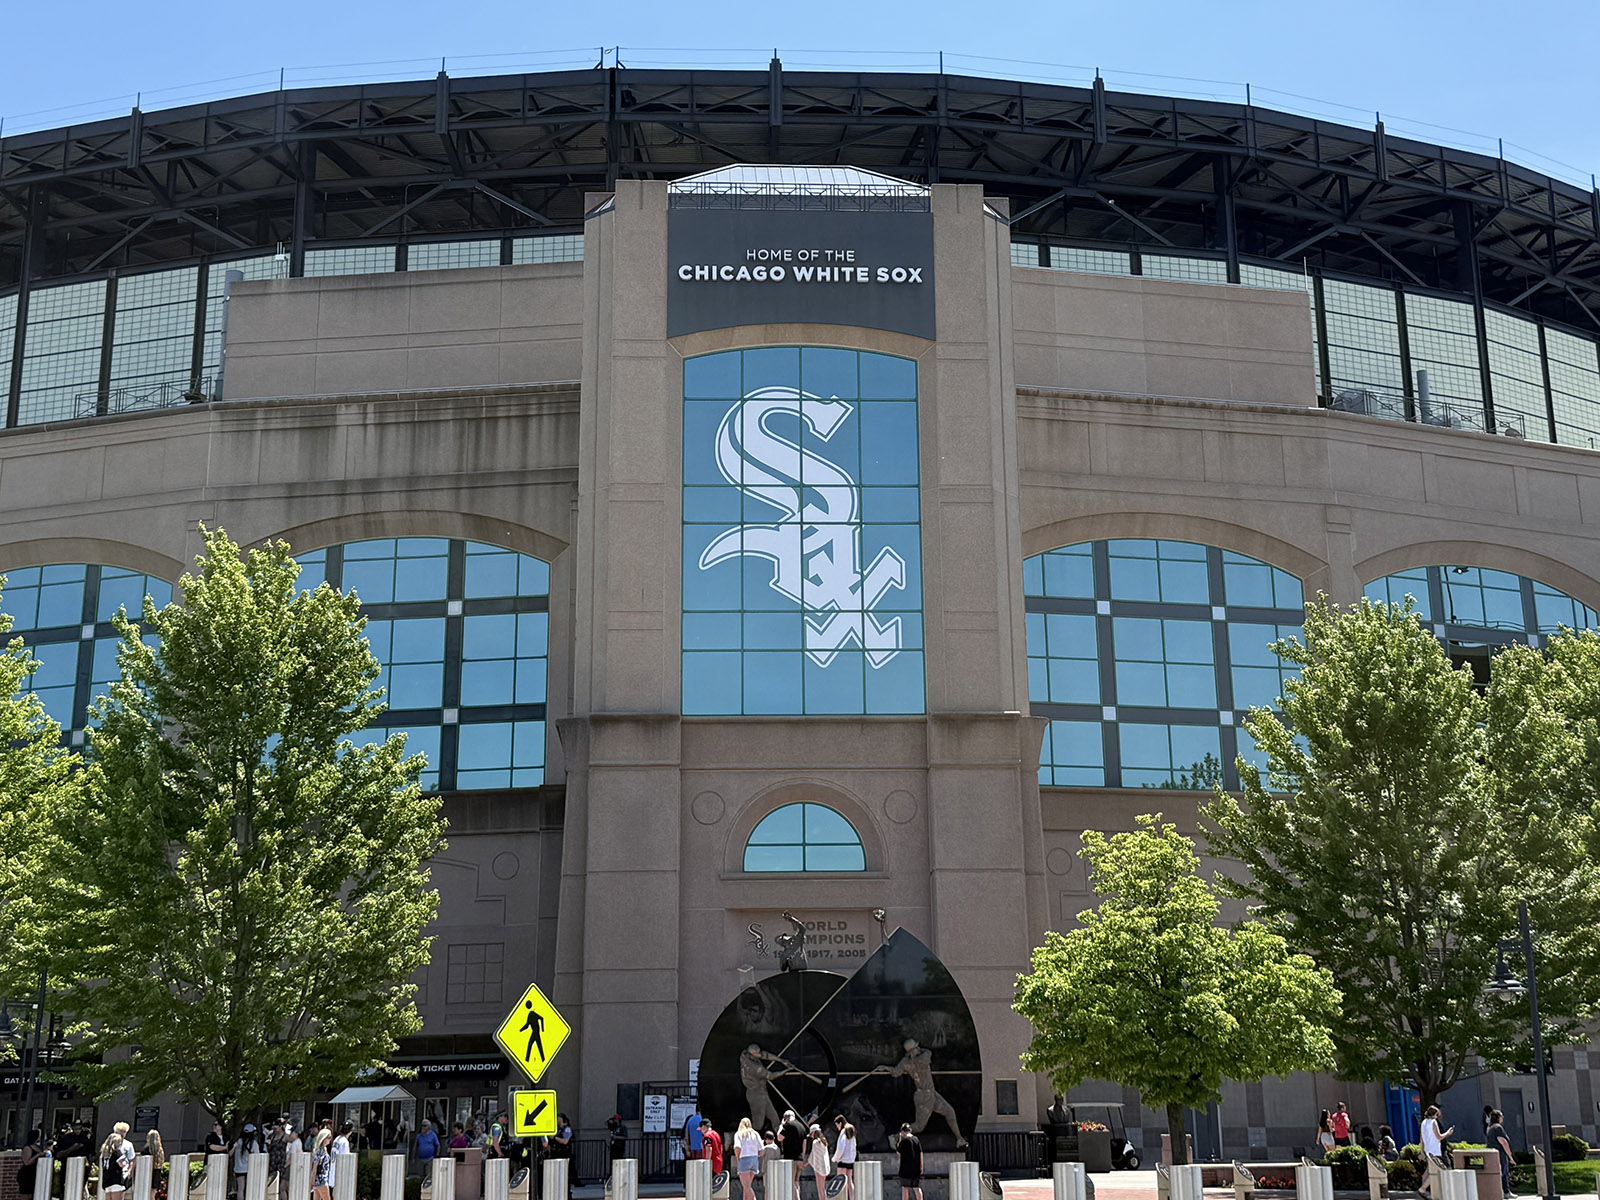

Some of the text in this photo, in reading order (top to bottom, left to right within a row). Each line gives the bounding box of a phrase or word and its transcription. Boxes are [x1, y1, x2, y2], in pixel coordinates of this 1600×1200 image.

[746, 249, 856, 262] HOME OF THE
[677, 264, 924, 284] CHICAGO WHITE SOX
[837, 949, 867, 958] 2005
[422, 1064, 457, 1073] TICKET
[458, 1063, 501, 1072] WINDOW
[434, 1081, 441, 1089] 9
[488, 1080, 498, 1088] 10
[715, 1176, 724, 1185] 9
[829, 1178, 842, 1190] 11
